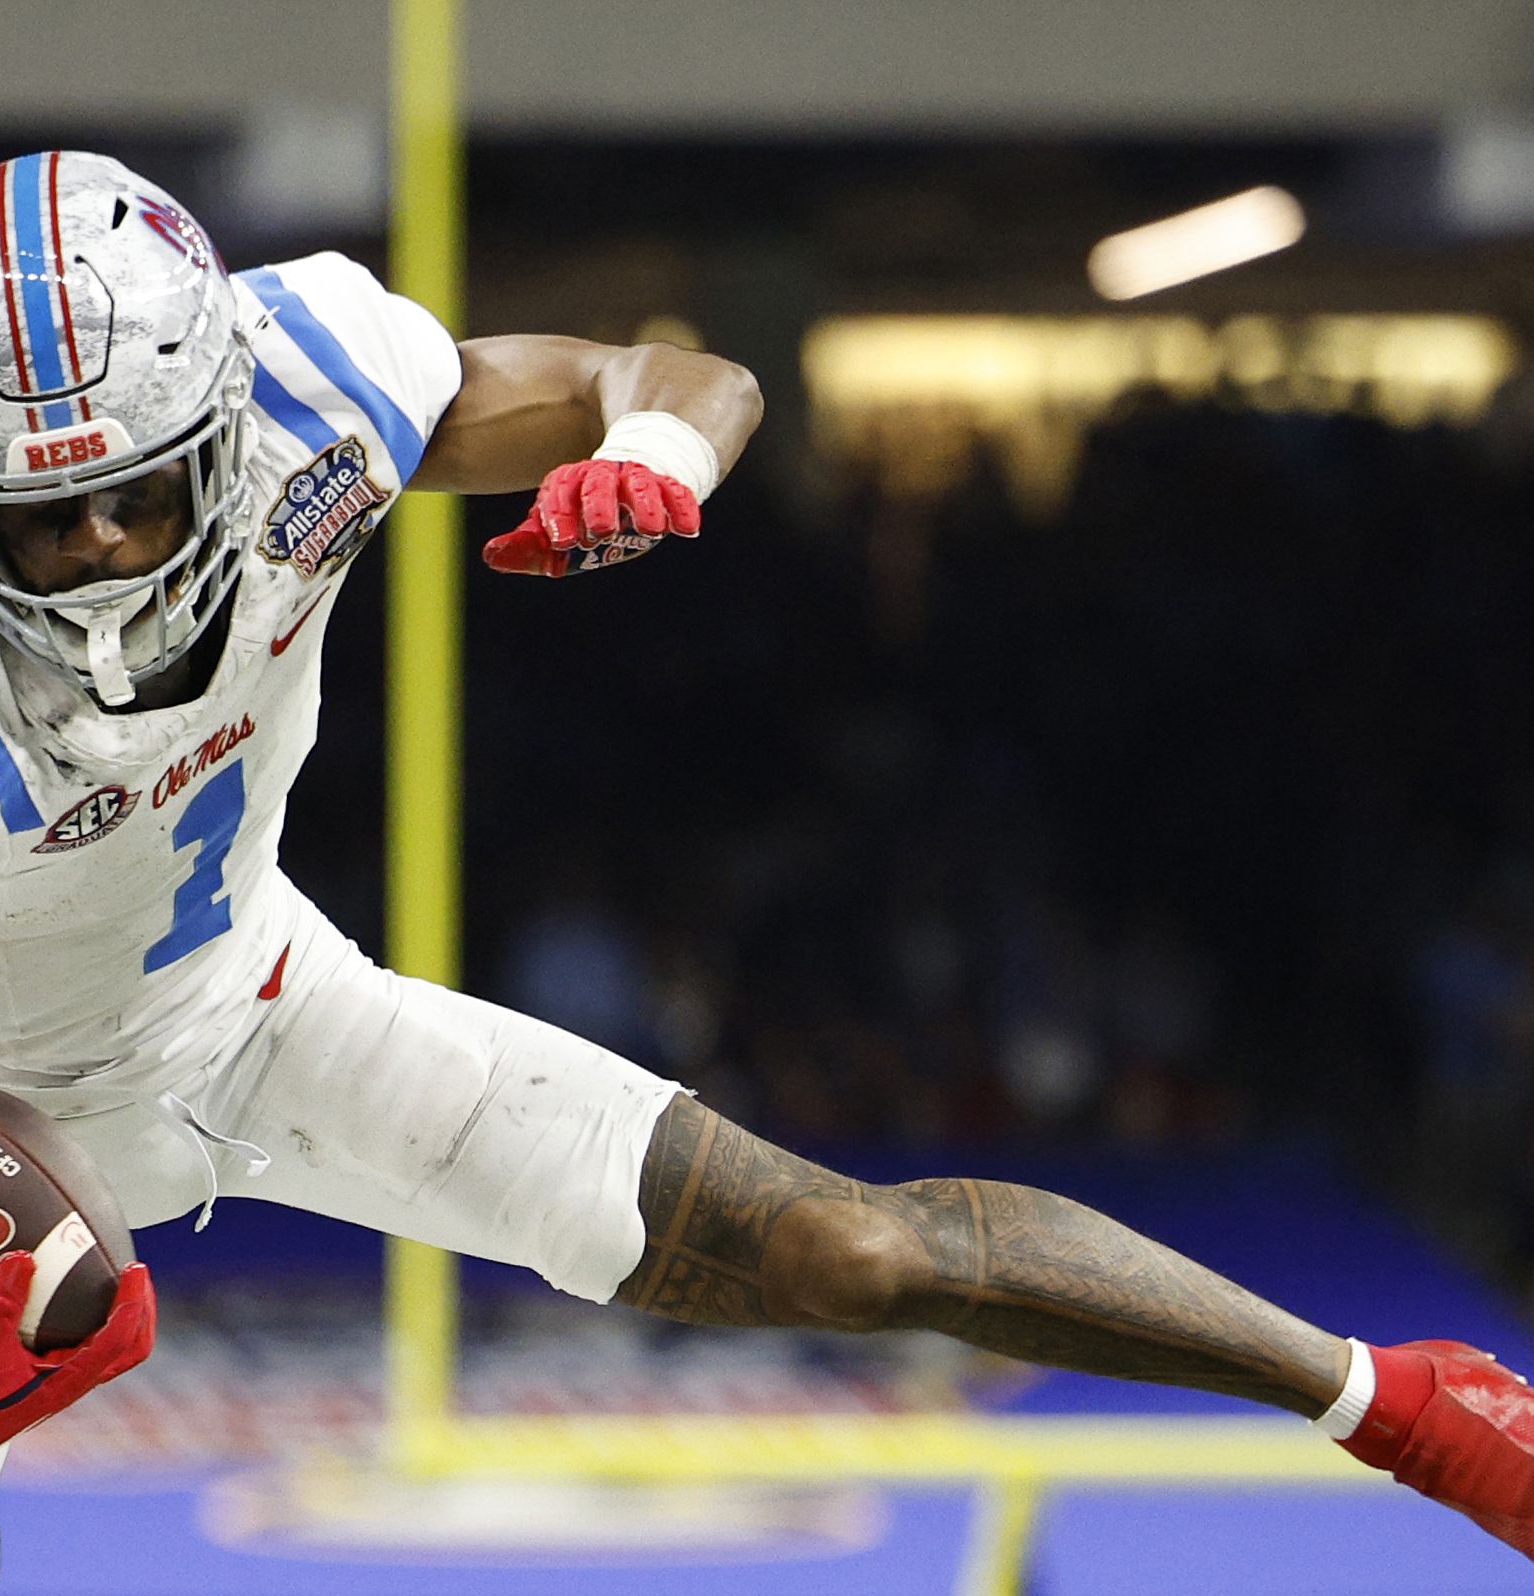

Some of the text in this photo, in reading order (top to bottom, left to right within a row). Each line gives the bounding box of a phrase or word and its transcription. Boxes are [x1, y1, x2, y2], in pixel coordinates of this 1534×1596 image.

[25, 432, 107, 472] REBS
[285, 467, 357, 550] Allstate
[153, 712, 256, 810] Ole Miss
[56, 793, 122, 841] SEC
[143, 757, 244, 975] 1
